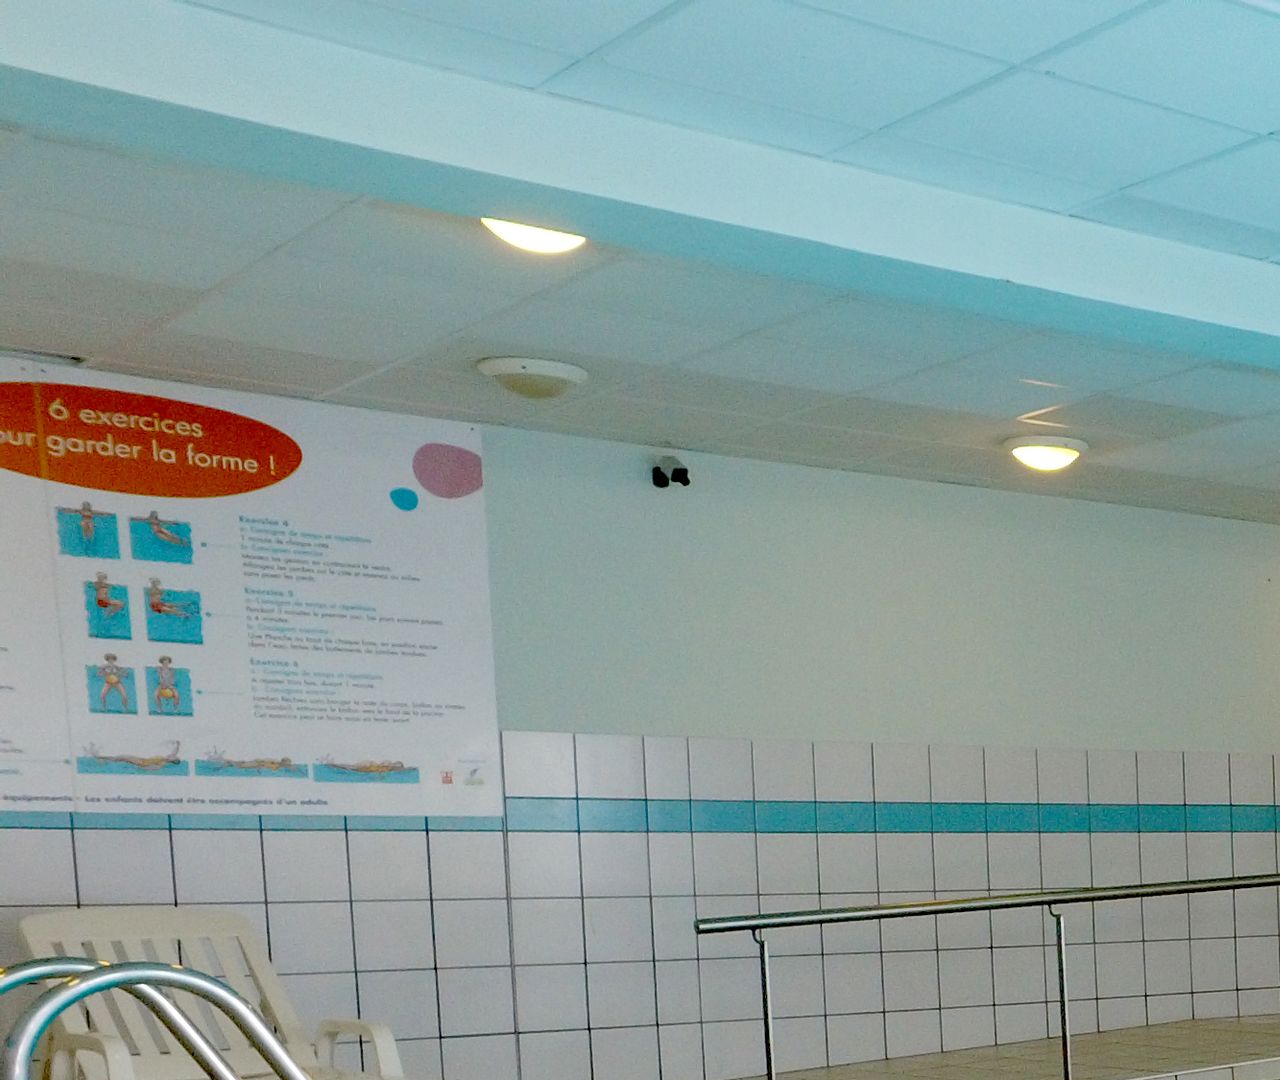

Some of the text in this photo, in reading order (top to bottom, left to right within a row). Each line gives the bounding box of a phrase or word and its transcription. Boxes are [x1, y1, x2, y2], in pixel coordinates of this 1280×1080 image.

[49, 399, 203, 438] 6 exercices
[46, 433, 142, 458] garder
[152, 439, 177, 464] la
[187, 442, 259, 473] forme
[269, 455, 277, 475] !
